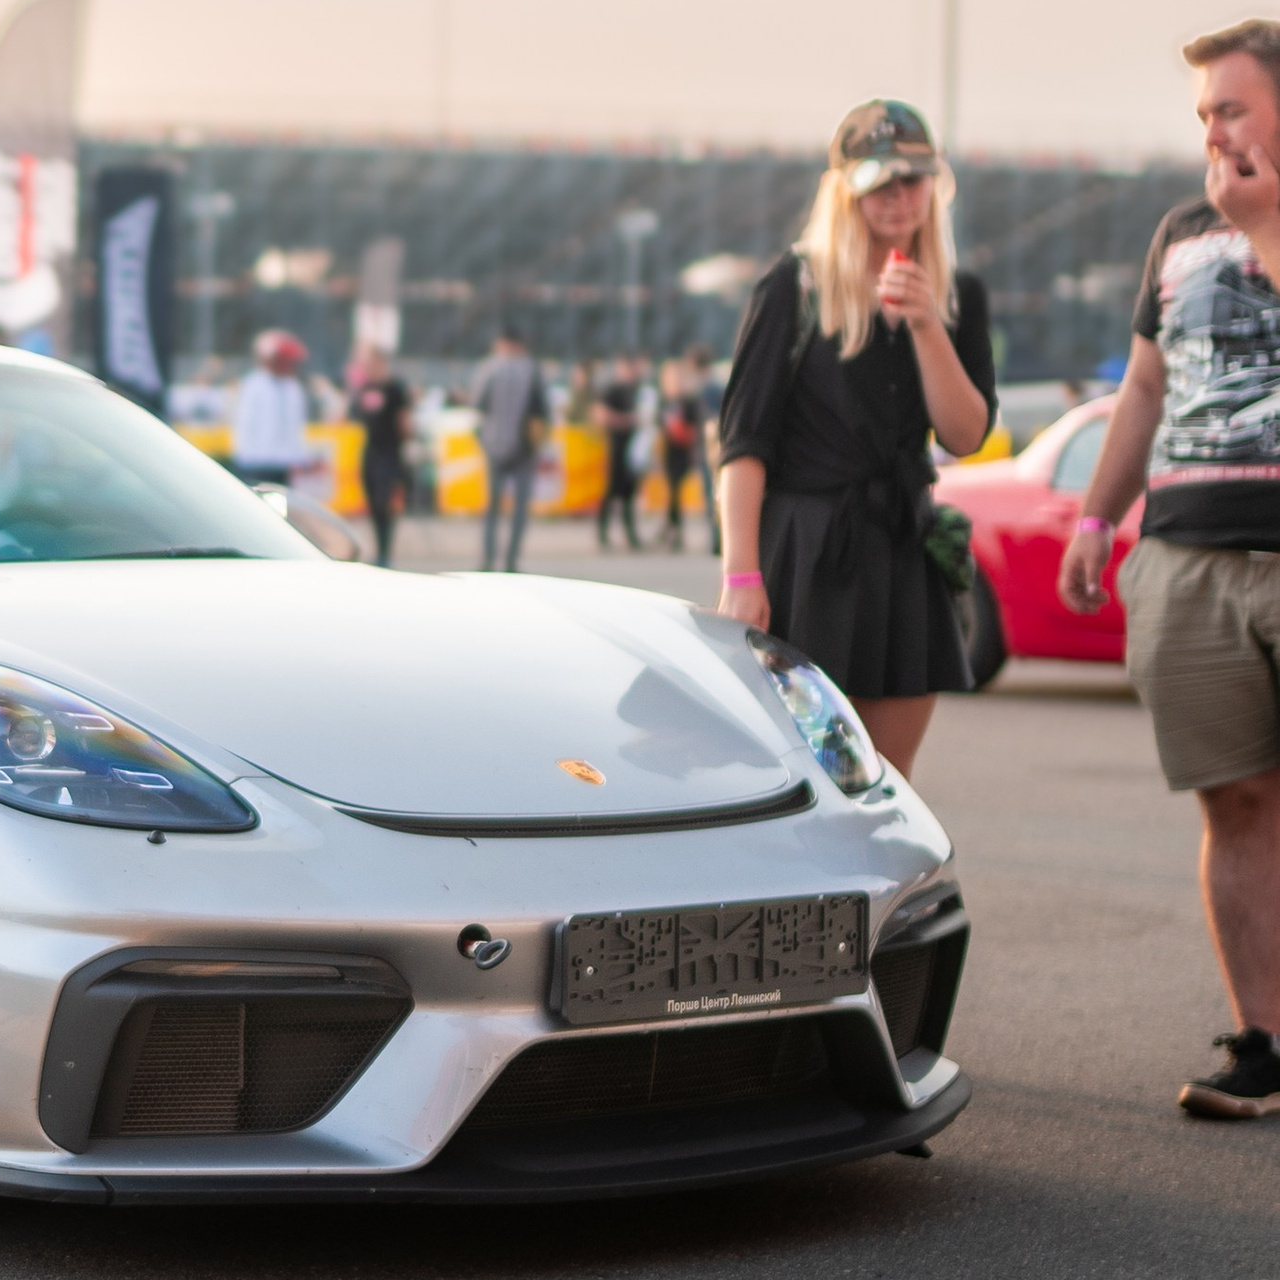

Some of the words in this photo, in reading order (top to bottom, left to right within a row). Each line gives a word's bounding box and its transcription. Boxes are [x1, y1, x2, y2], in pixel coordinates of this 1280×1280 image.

[667, 1000, 699, 1014] Порше
[701, 996, 730, 1011] Центр
[730, 989, 781, 1006] Ленинский
